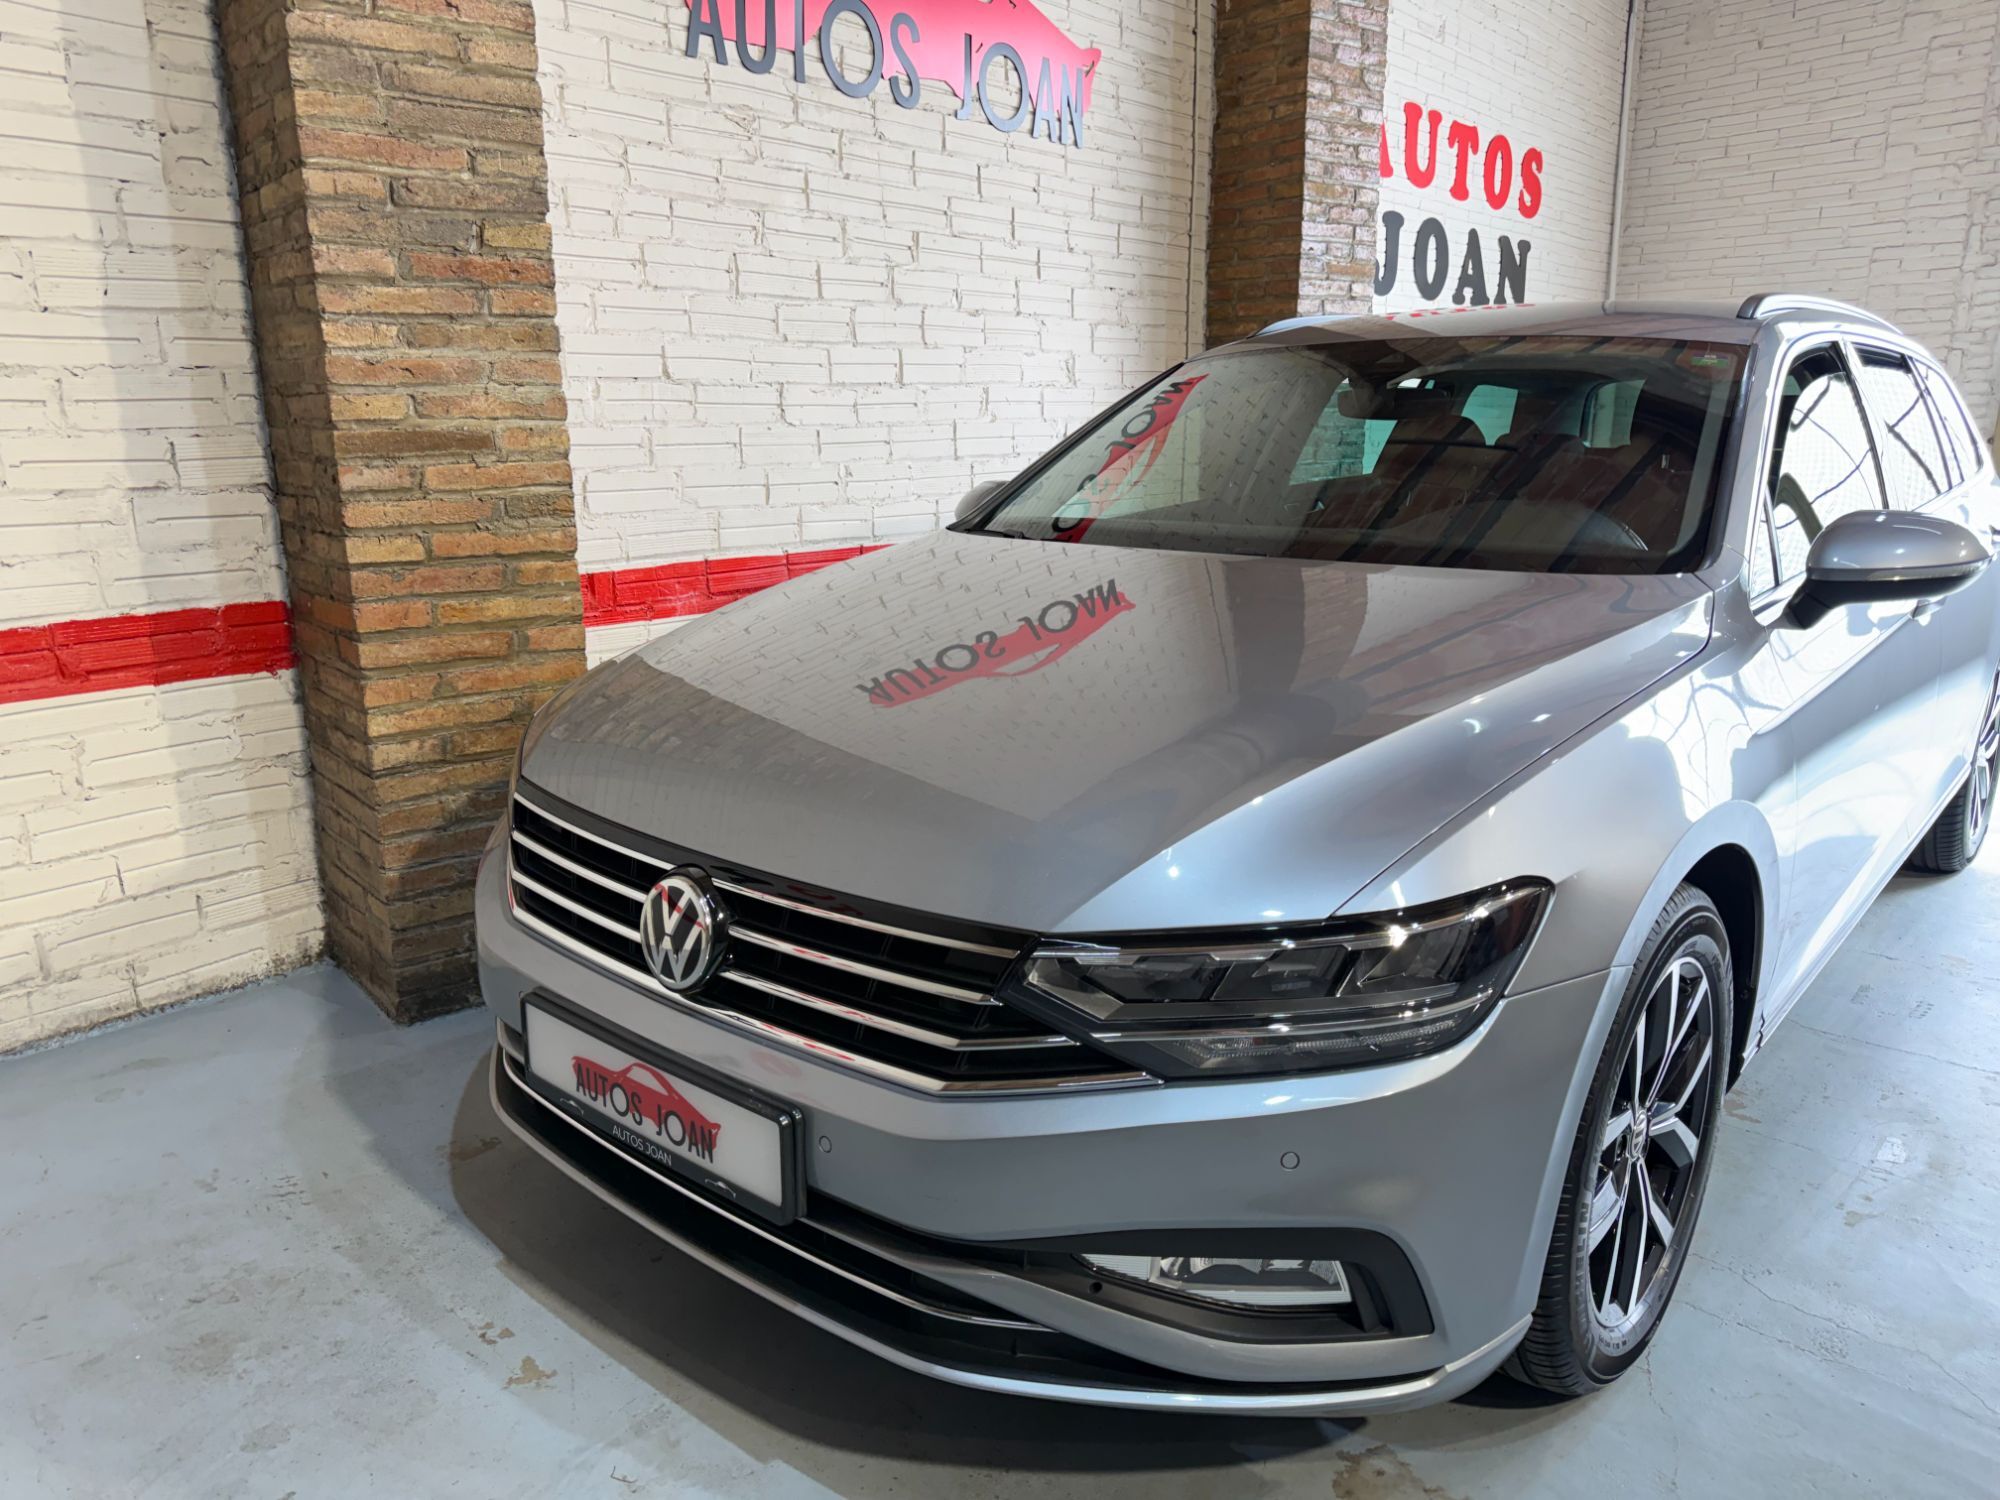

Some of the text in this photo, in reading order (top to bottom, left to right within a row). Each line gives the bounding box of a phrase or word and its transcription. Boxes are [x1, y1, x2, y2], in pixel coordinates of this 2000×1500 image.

[956, 33, 1084, 149] JOAN
[1373, 209, 1532, 306] JOAN
[575, 1063, 714, 1164] AUTOS JOAN
[612, 1125, 672, 1167] AUTOS JOAN
